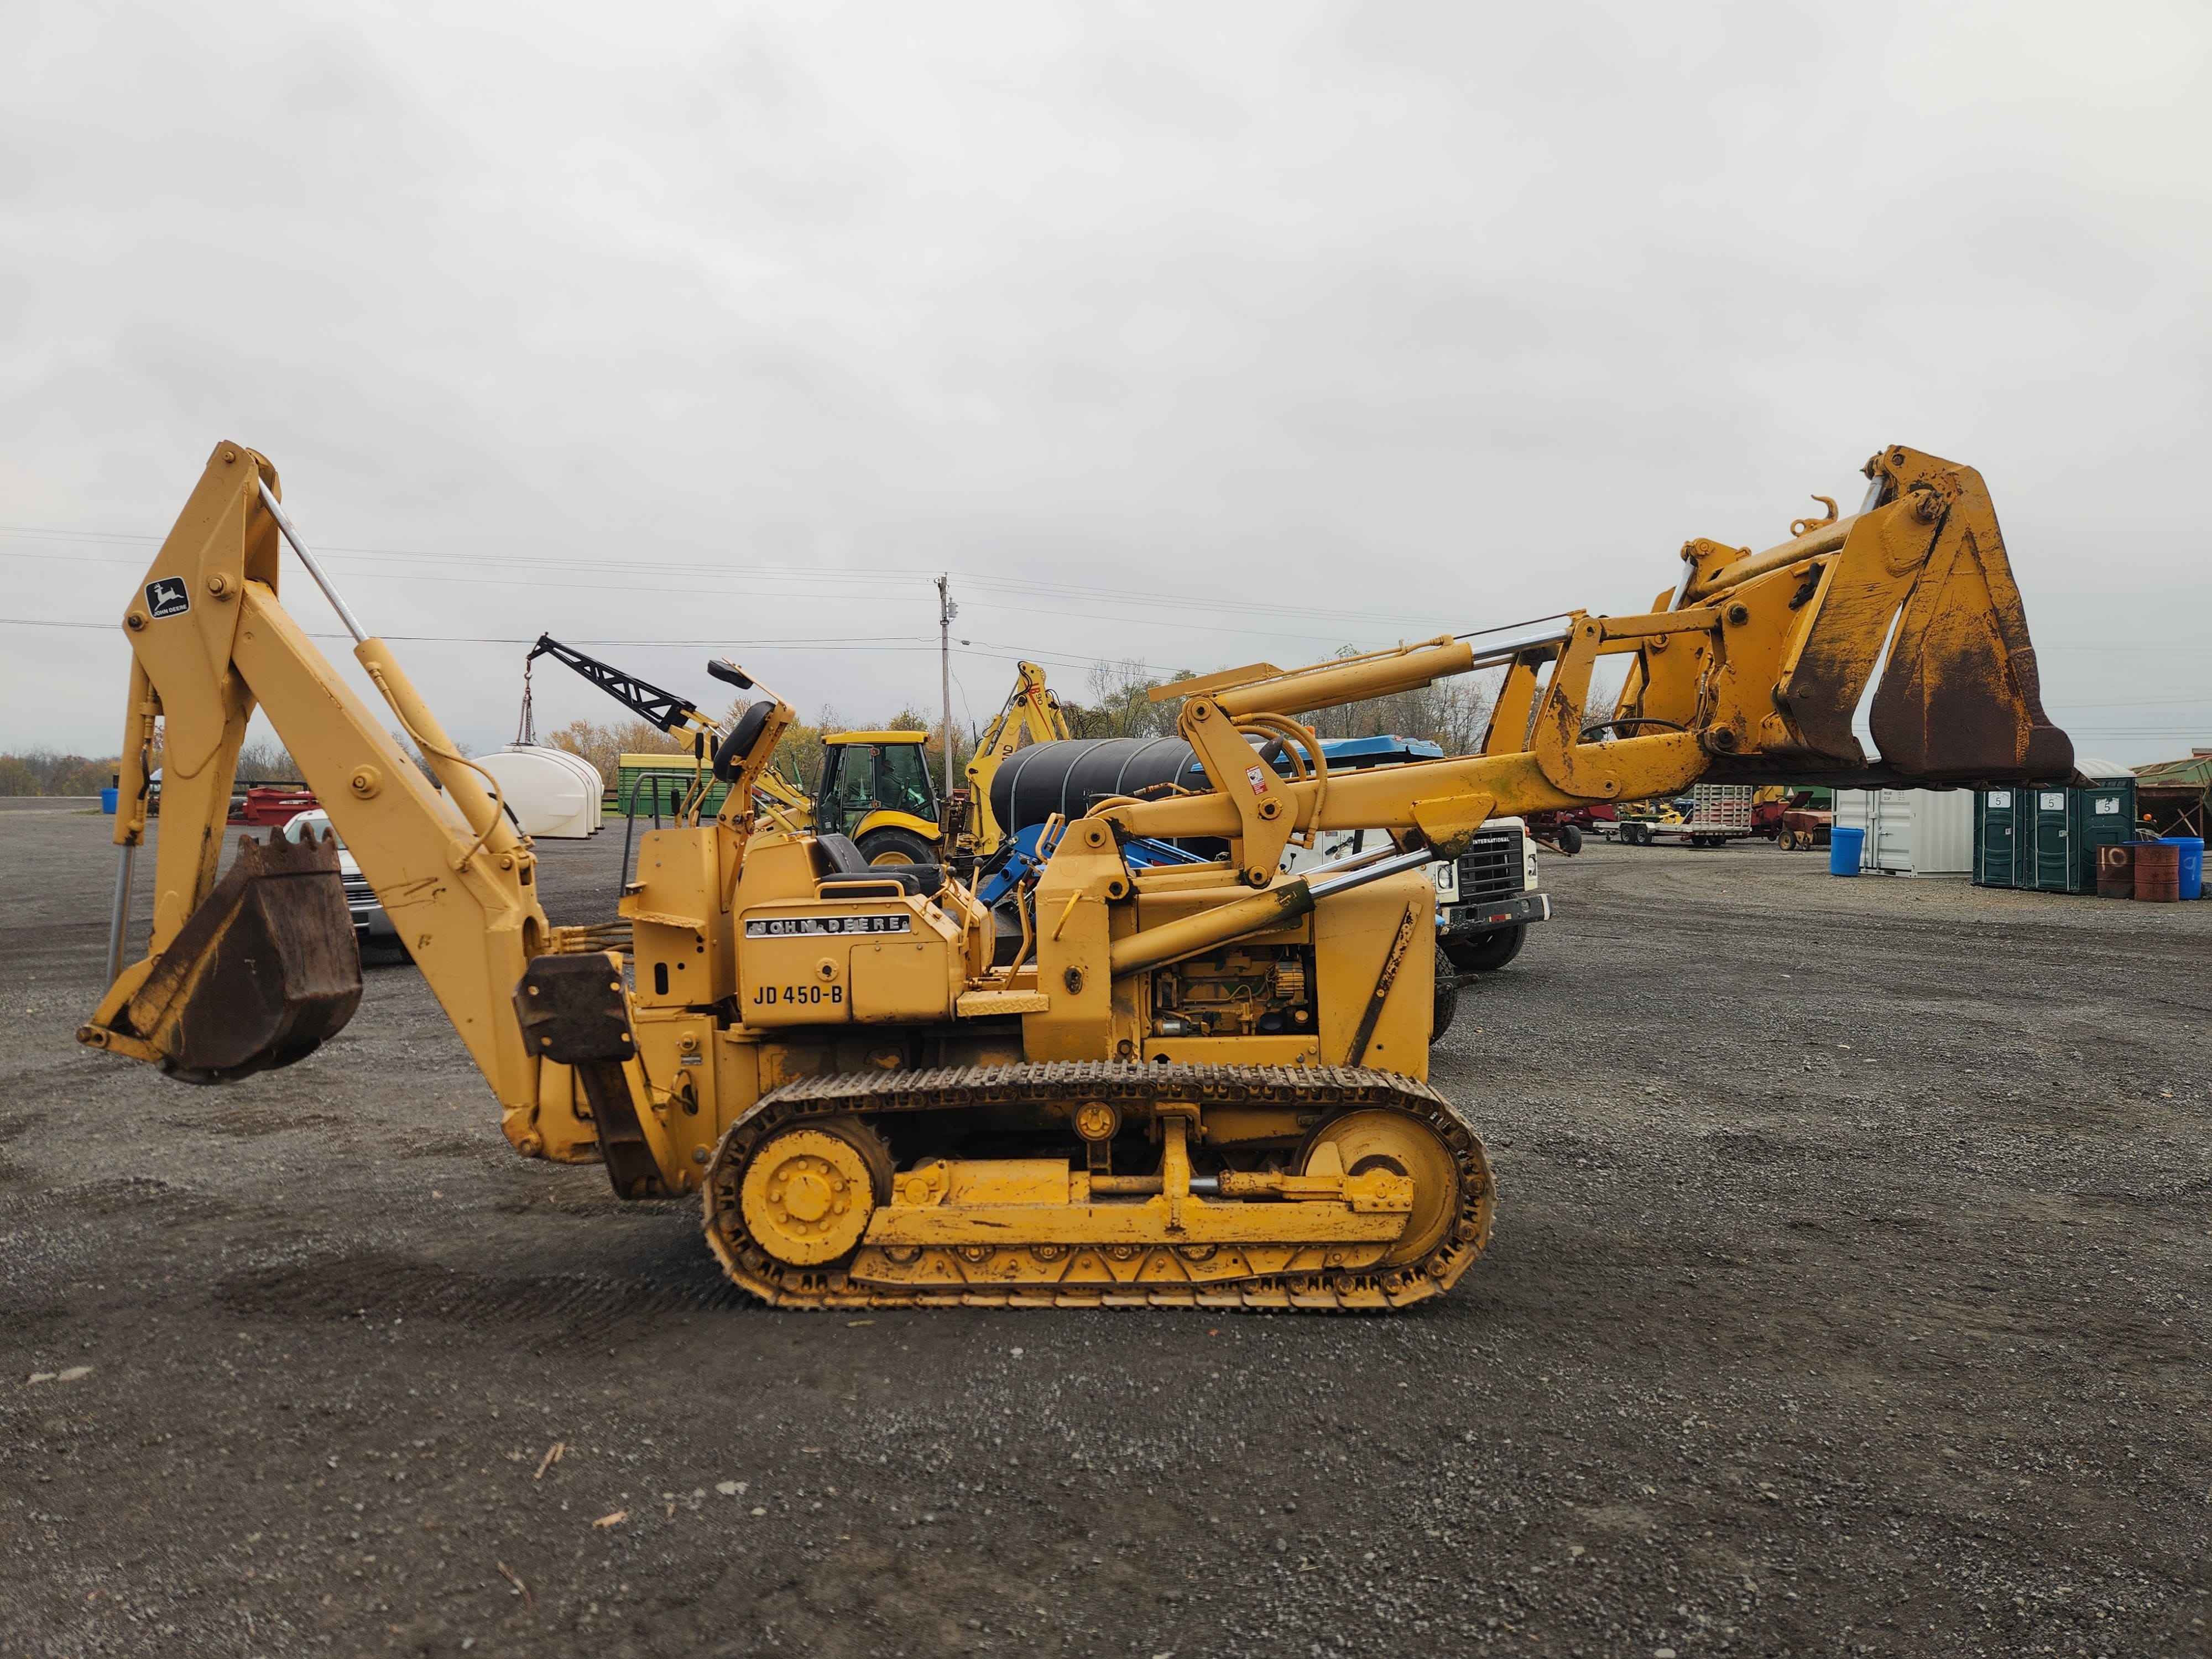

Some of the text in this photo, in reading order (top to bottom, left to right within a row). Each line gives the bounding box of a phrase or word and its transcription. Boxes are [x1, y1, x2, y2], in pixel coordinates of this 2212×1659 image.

[1995, 797, 2001, 806] 5
[2048, 799, 2054, 808] 5
[2105, 803, 2110, 812] 5
[1473, 837, 1510, 845] INTERNATIONAL
[2101, 847, 2127, 871] 10
[2184, 857, 2197, 880] 9
[755, 917, 900, 935] JOHN DEERE
[753, 985, 843, 1005] JD 450-B
